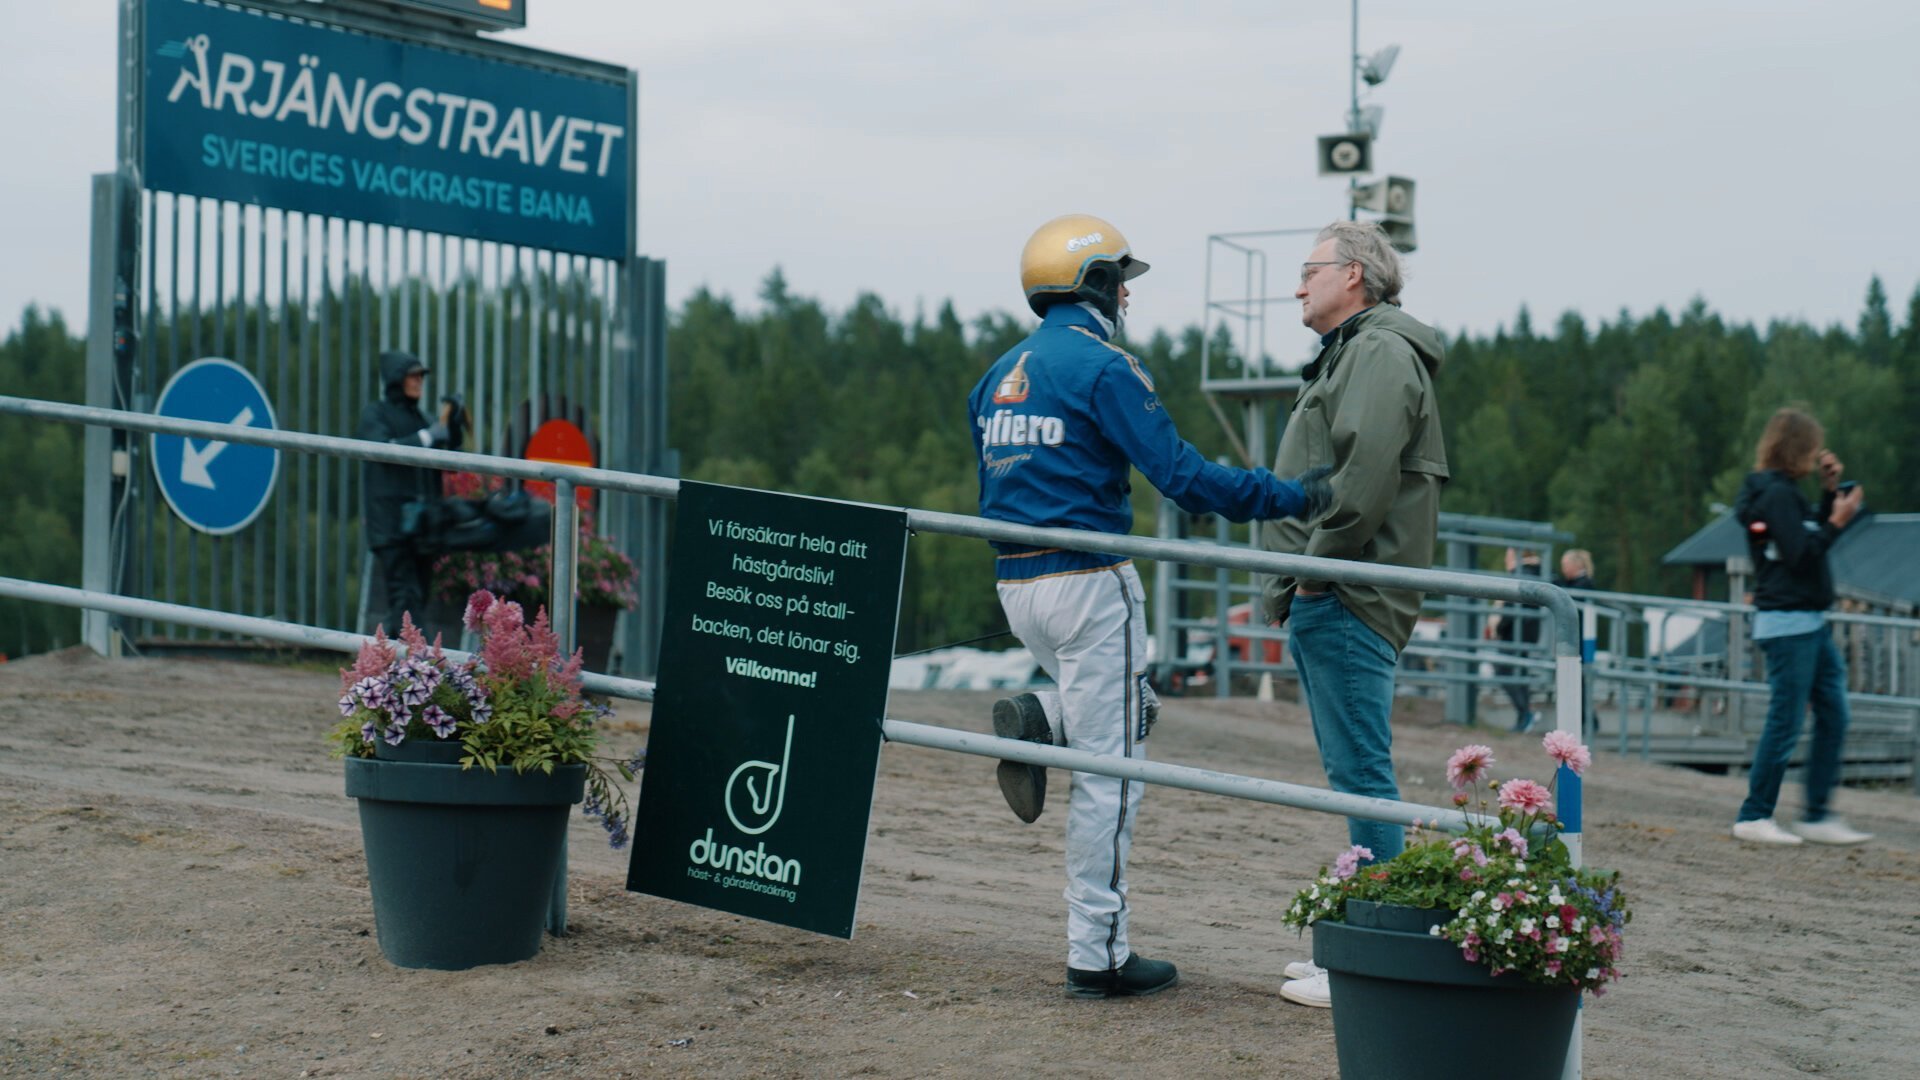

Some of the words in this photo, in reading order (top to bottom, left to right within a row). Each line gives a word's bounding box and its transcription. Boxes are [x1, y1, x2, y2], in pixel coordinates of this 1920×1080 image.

[167, 34, 624, 177] ÅRJÄNGSTRAVET
[202, 133, 345, 187] SVERIGES
[351, 158, 513, 214] VACKRASTE
[519, 186, 594, 226] BANA
[708, 518, 724, 537] Vi
[726, 520, 797, 548] försäkrar
[799, 531, 836, 555] hela
[838, 539, 868, 560] ditt
[731, 552, 835, 586] hästgårdsliv!
[705, 580, 753, 605] Besök
[755, 592, 783, 610] oss
[785, 594, 810, 617] på
[812, 600, 856, 621] stall-
[691, 613, 754, 644] backen,
[756, 625, 785, 647] det
[787, 630, 832, 655] lönar
[833, 639, 862, 665] sig.
[725, 655, 818, 690] Välkomna!
[689, 827, 801, 886] dunstan
[687, 866, 713, 881] häst-
[713, 872, 722, 884] &
[722, 874, 797, 904] gårdsförsäkring
